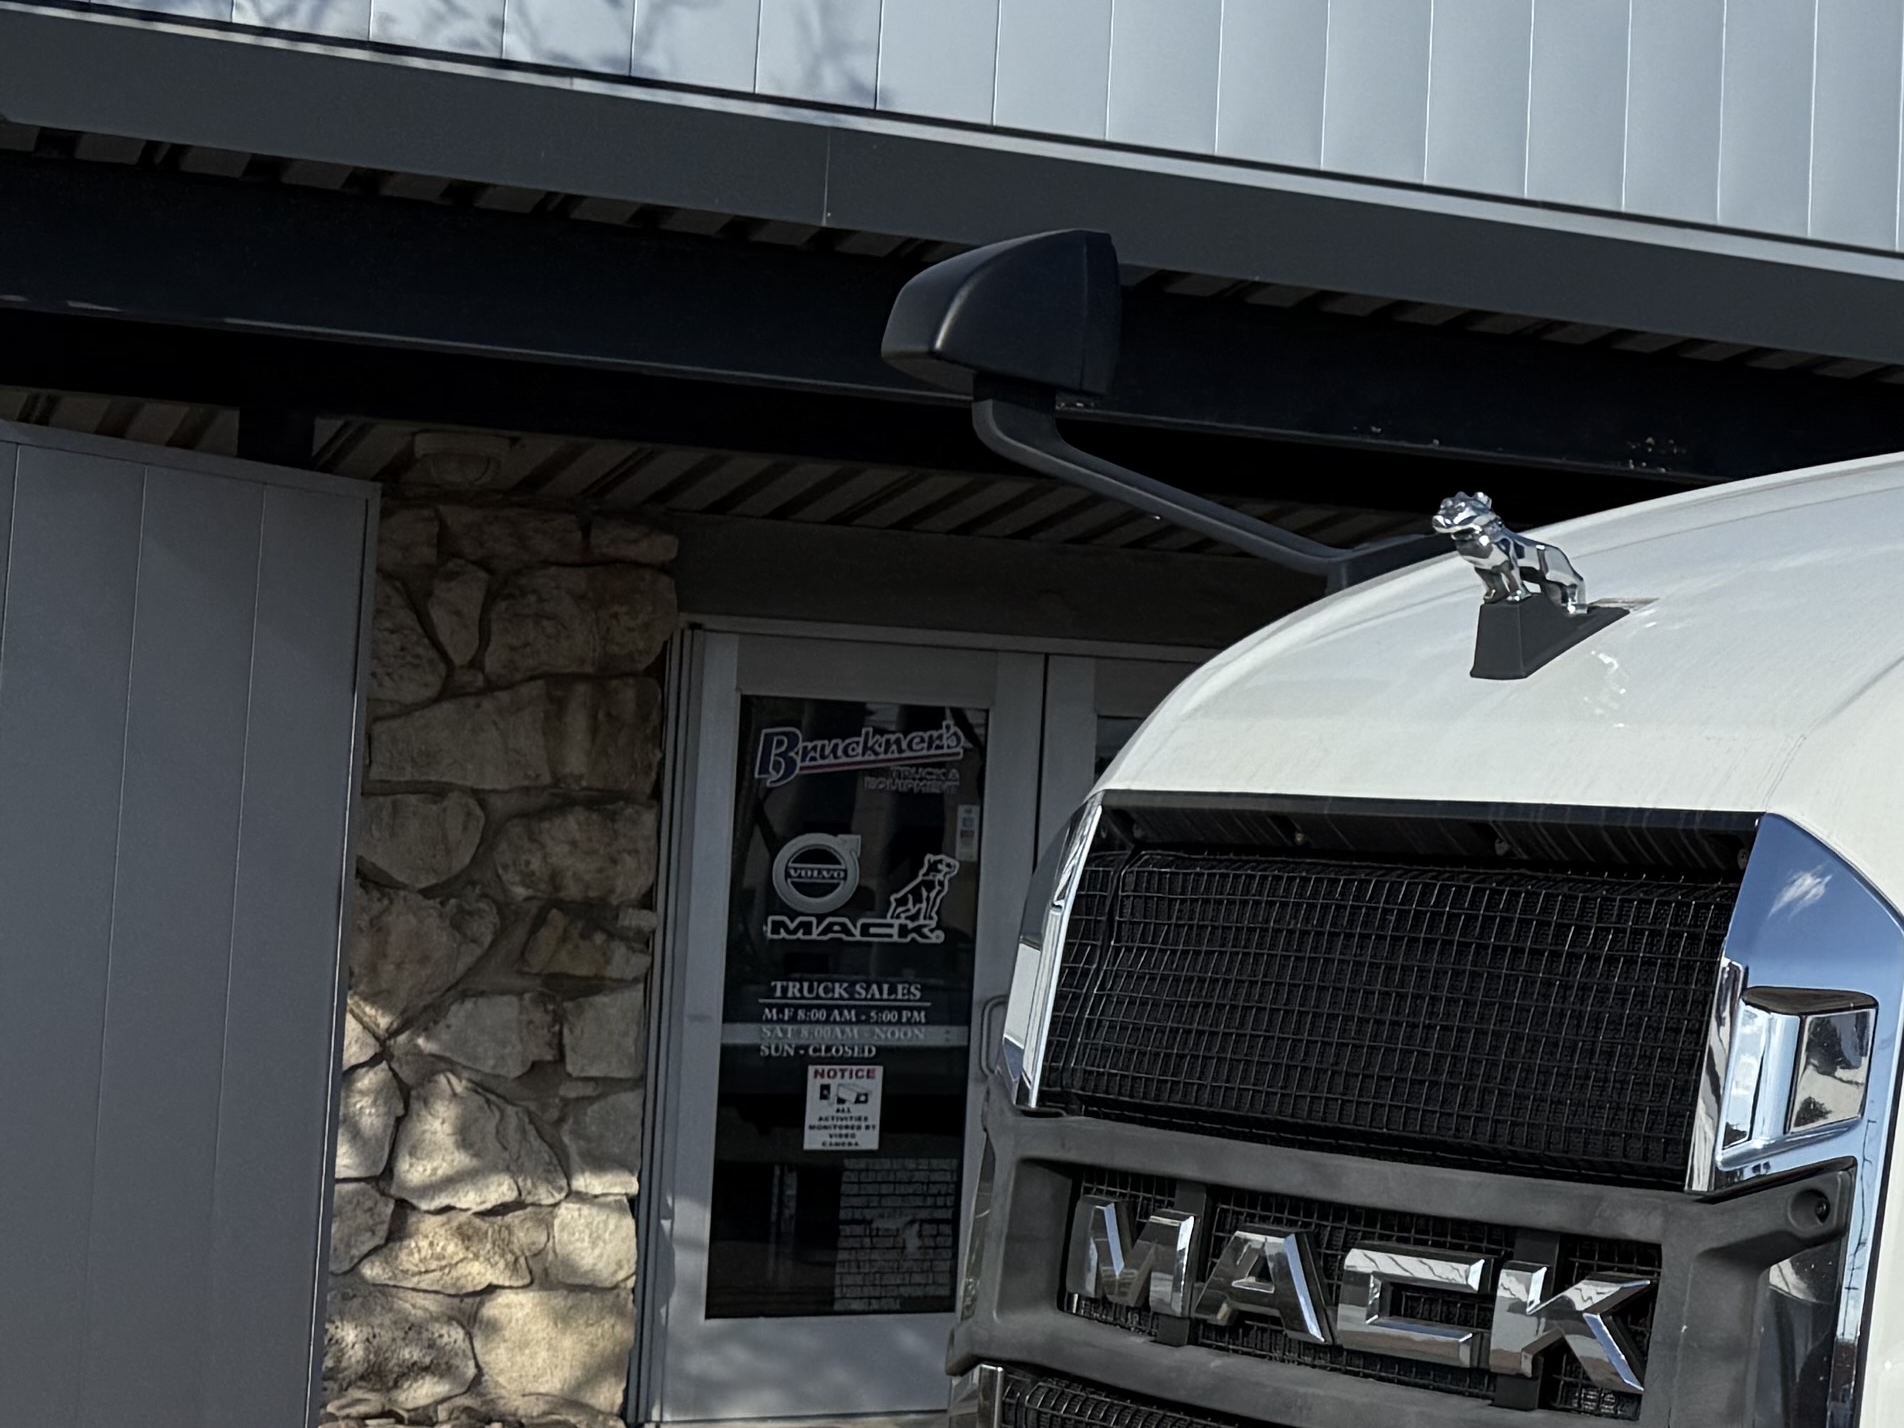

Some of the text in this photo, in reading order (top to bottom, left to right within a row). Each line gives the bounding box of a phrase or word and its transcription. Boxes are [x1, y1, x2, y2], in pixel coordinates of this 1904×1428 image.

[755, 720, 964, 788] Bruckner's
[789, 867, 845, 879] VOLVO
[767, 915, 938, 943] MACK
[771, 981, 922, 1000] TRUCK SALES
[762, 1008, 794, 1021] M-F
[797, 1008, 826, 1021] 8:00
[830, 1009, 856, 1022] AM
[870, 1010, 898, 1022] 5:00
[901, 1010, 926, 1023] PM
[761, 1026, 796, 1039] SAT
[873, 1027, 925, 1040] NOON
[760, 1044, 795, 1057] SUN
[808, 1044, 876, 1058] CLOSED
[813, 1068, 876, 1079] NOTICE
[1066, 1194, 1656, 1394] MACK
